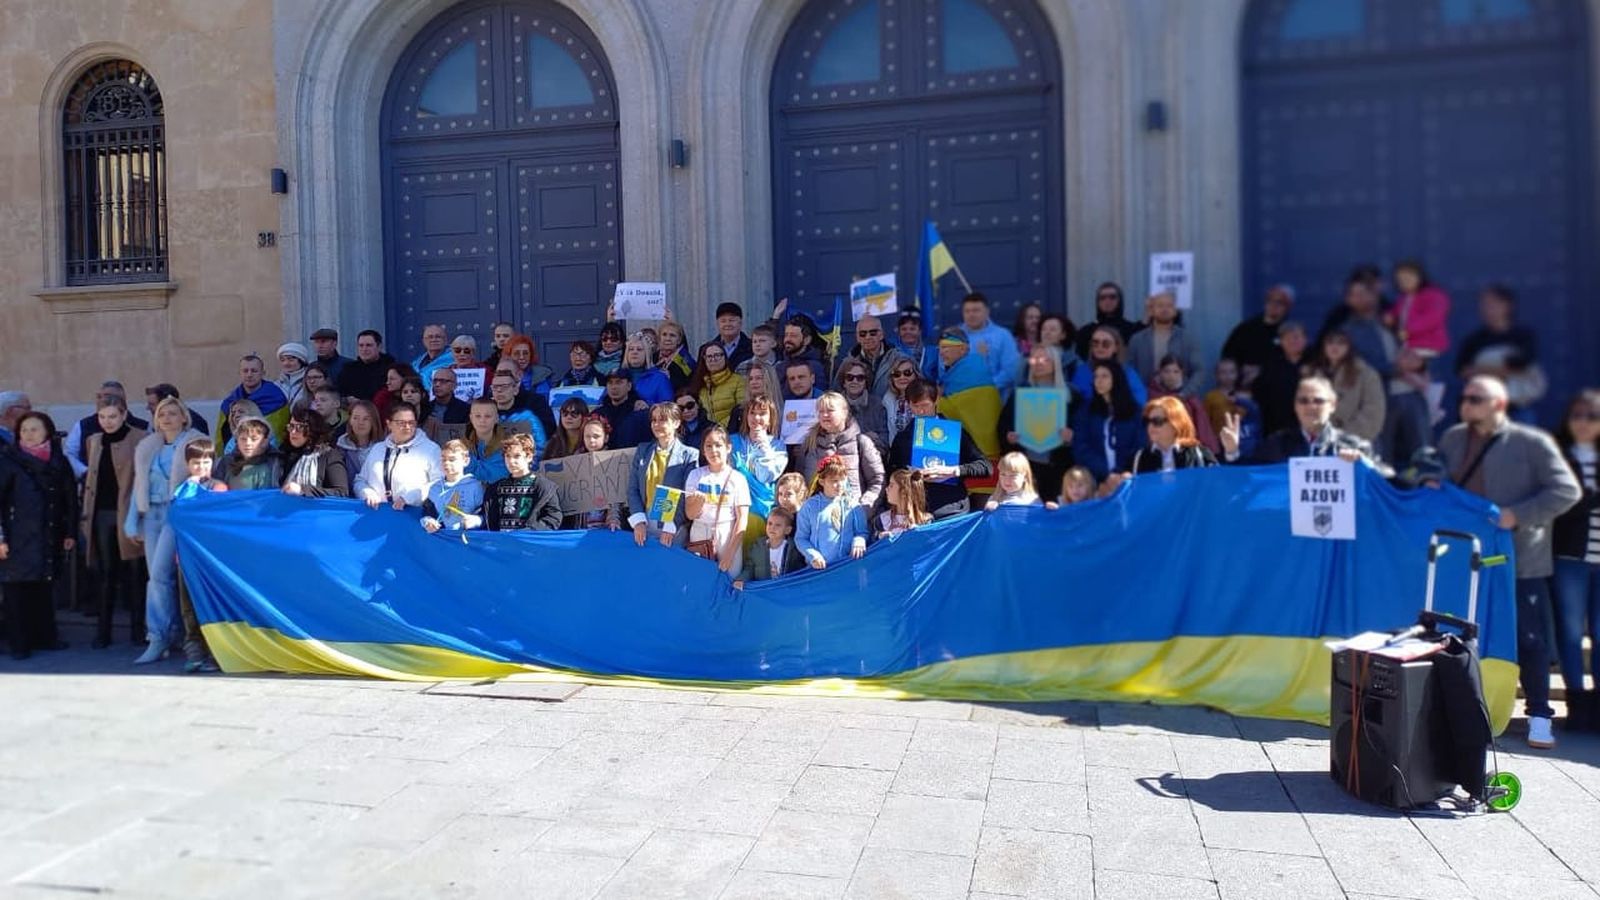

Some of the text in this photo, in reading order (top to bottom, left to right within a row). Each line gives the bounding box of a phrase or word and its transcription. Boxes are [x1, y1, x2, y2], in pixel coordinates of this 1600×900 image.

[565, 451, 631, 478] VIVA
[1304, 469, 1340, 483] FREE
[1300, 488, 1346, 503] AZOV!
